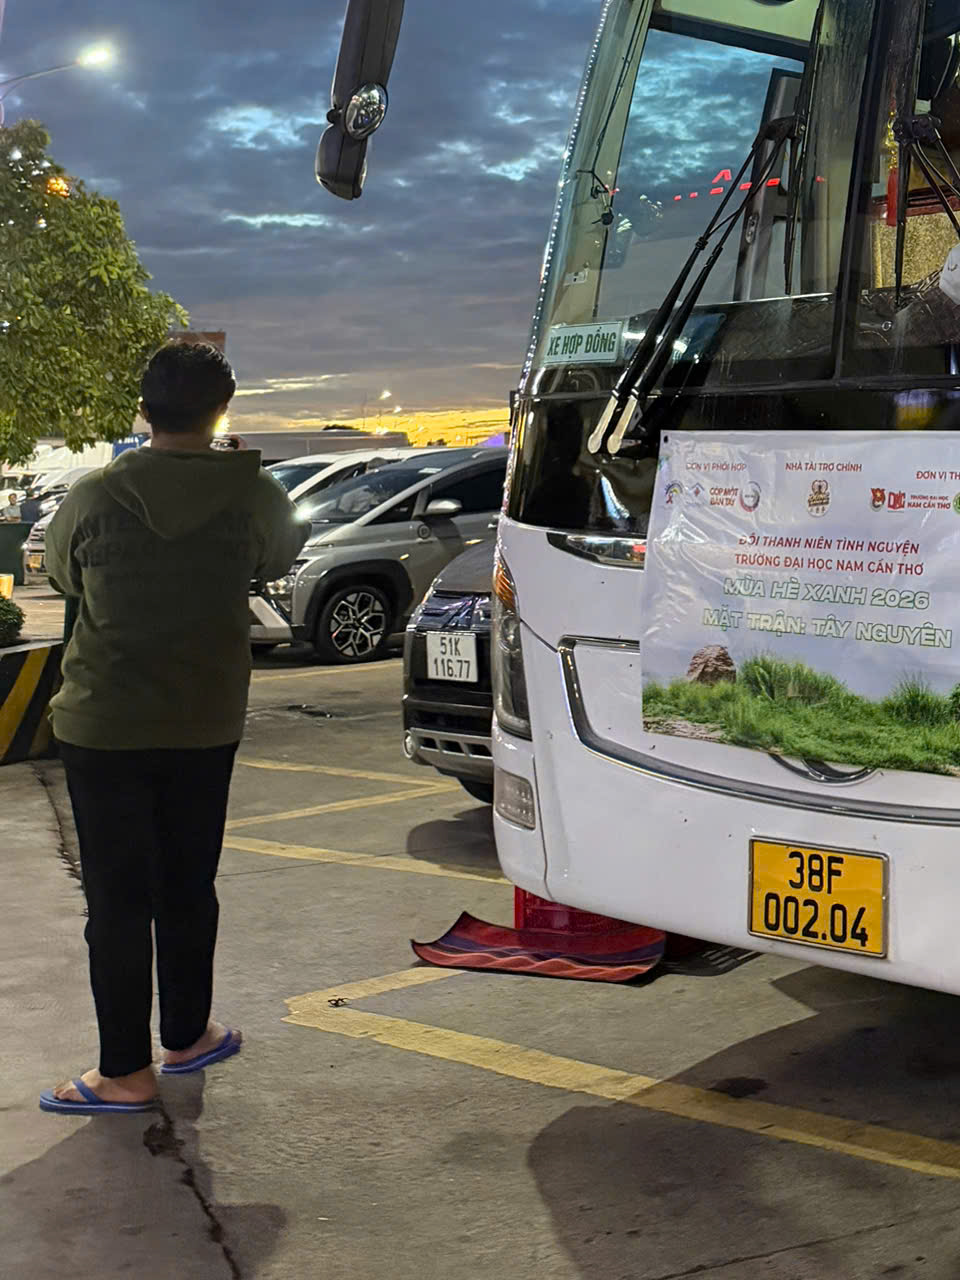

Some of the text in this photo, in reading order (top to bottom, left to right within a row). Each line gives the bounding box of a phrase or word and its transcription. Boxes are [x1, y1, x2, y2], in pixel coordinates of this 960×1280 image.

[547, 326, 616, 359] XE HỢP ĐỒNG
[785, 461, 802, 471] NHÀ
[805, 461, 817, 471] TÀI
[836, 461, 862, 472] CHÍNH
[916, 470, 937, 480] ĐƠN
[938, 471, 947, 483] VỊ
[763, 535, 801, 548] THANH
[804, 535, 832, 550] NIÊN
[836, 536, 864, 551] TÌNH
[867, 539, 919, 557] NGUYỆN
[784, 556, 804, 571] ĐẠI
[807, 558, 833, 572] HỌC
[836, 559, 864, 572] NAM
[897, 562, 924, 576] THƠ
[724, 575, 930, 610] MÙA HÈ XANH 2026
[703, 604, 952, 648] MẶT TRẬN: TÂY NGUYÊN
[440, 636, 461, 656] 51K
[434, 657, 471, 679] 116.77
[788, 851, 844, 894] 38F
[764, 892, 869, 947] 002.04
